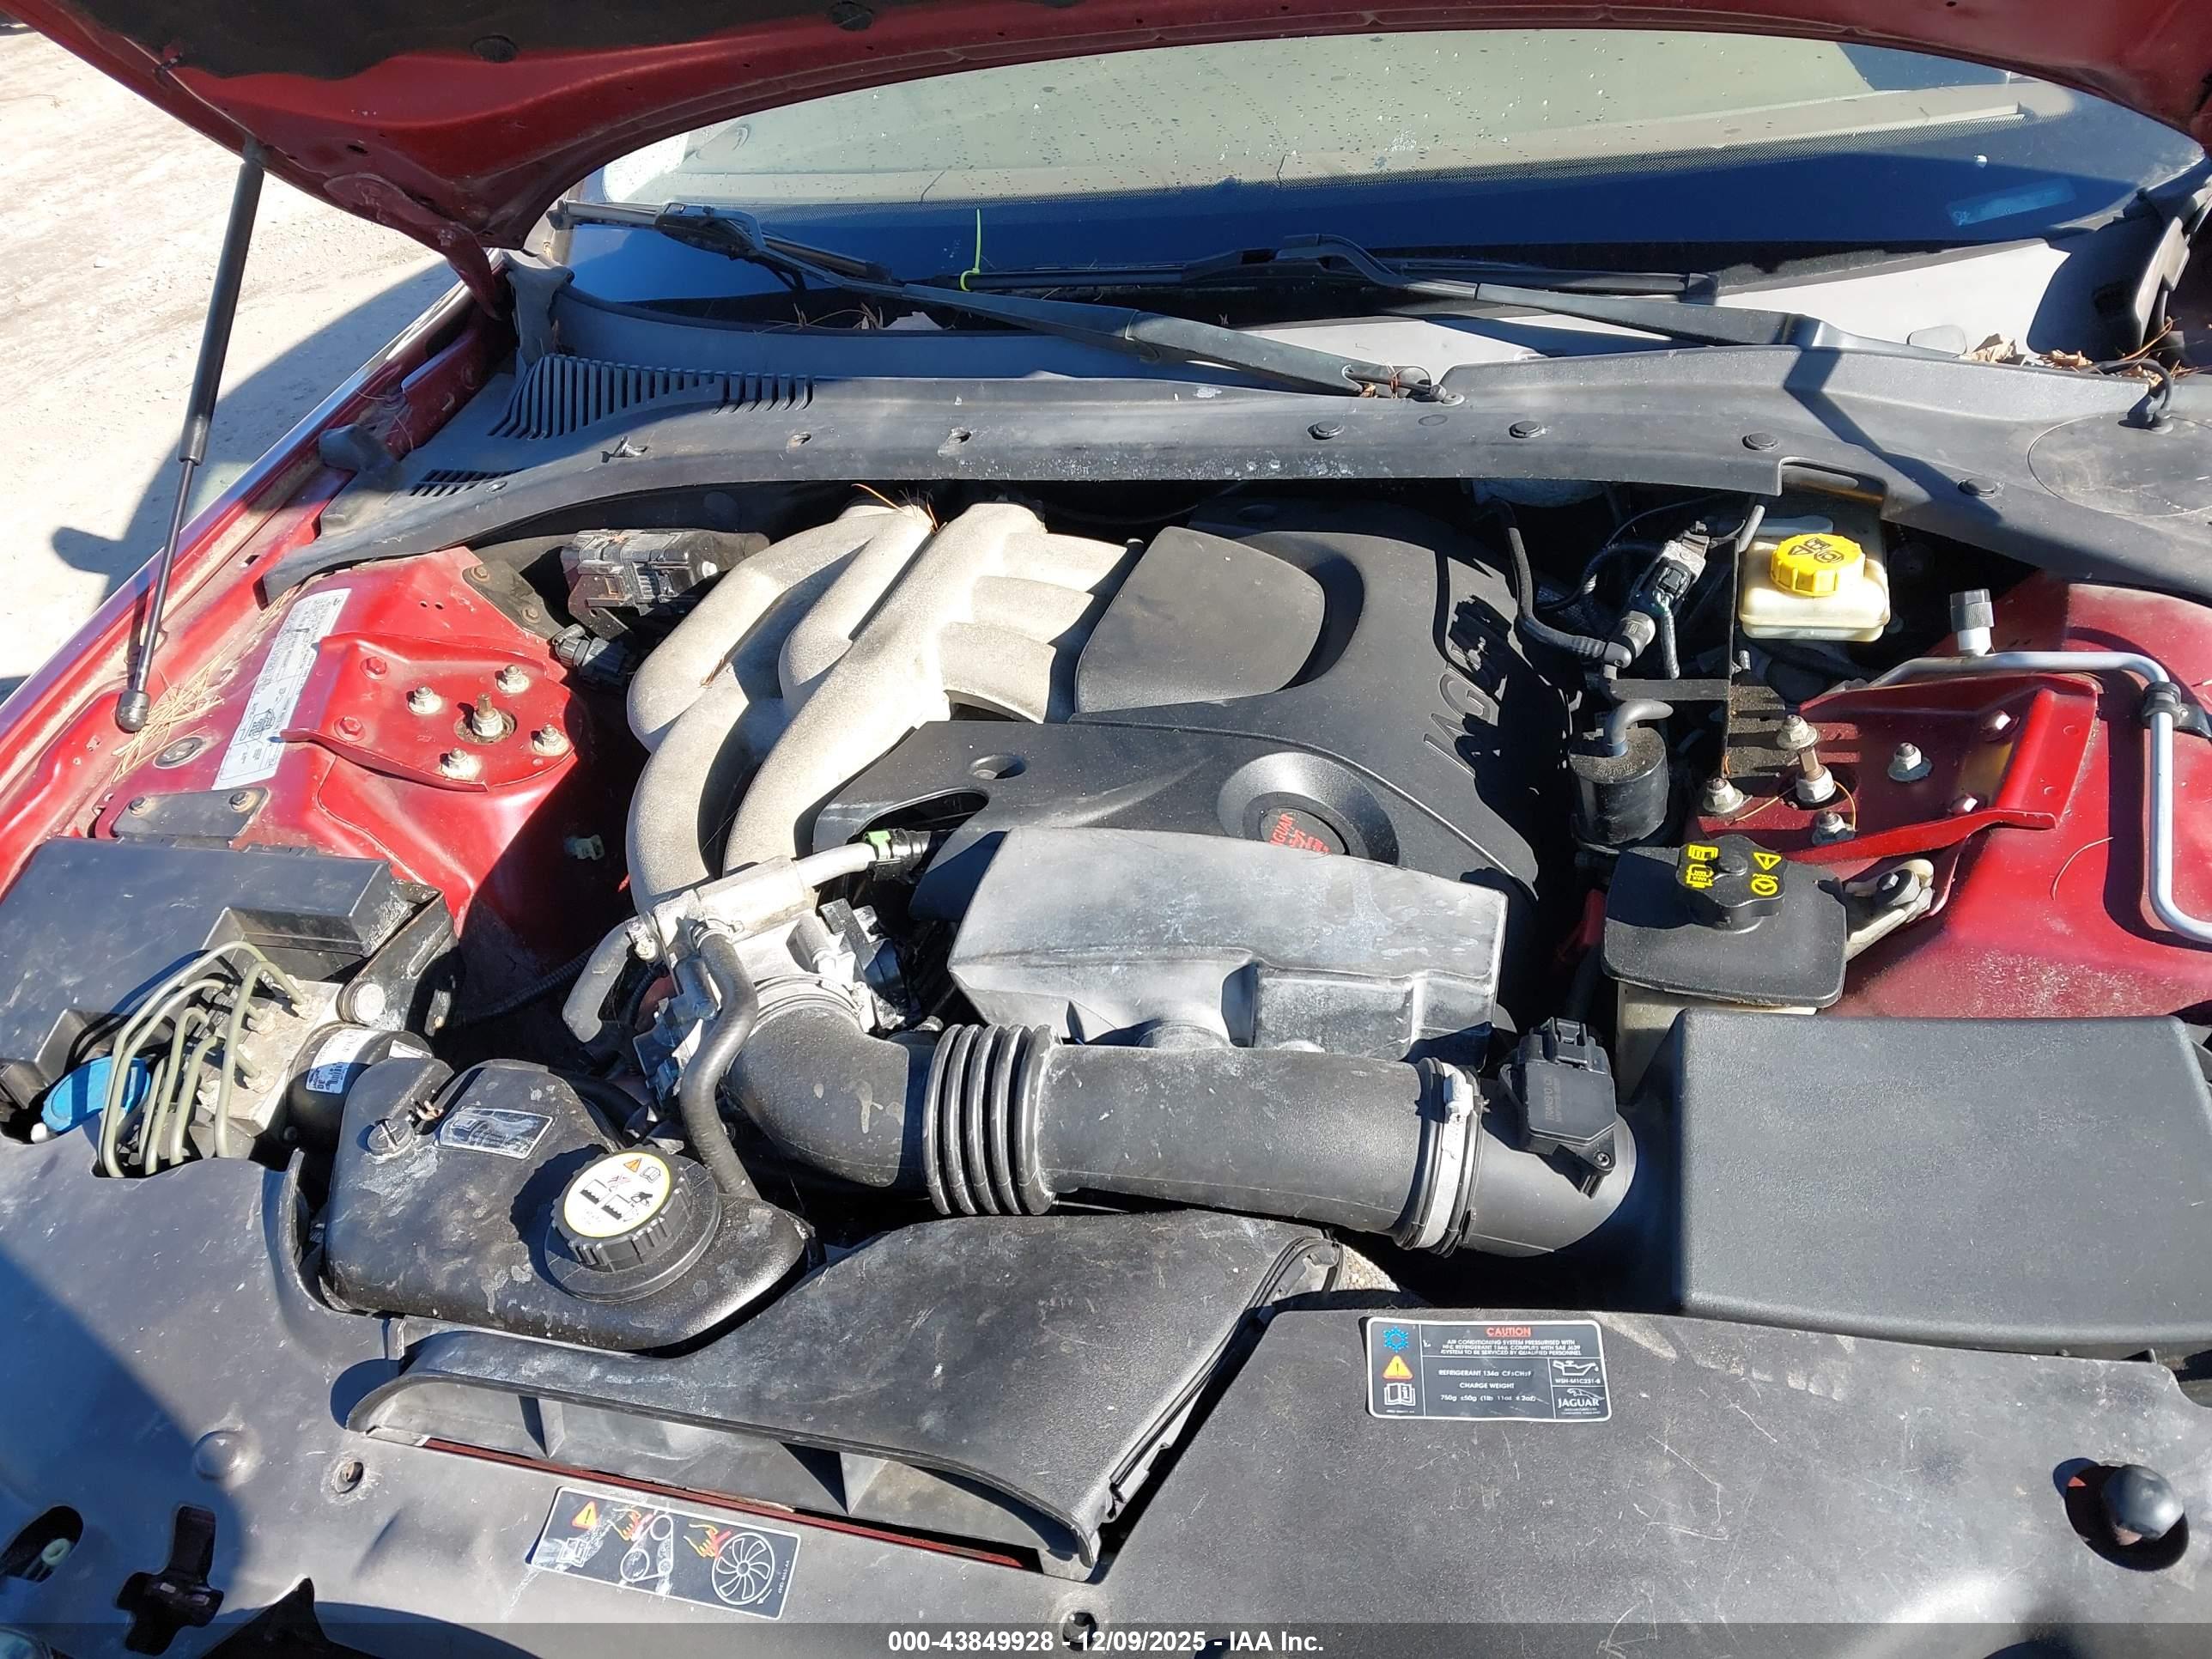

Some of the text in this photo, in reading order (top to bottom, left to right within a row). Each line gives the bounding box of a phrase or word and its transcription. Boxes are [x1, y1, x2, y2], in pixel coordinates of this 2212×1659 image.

[1270, 812, 1293, 845] GUAR
[1486, 1328, 1531, 1337] CAUTION
[1558, 1397, 1600, 1408] JAGUAR
